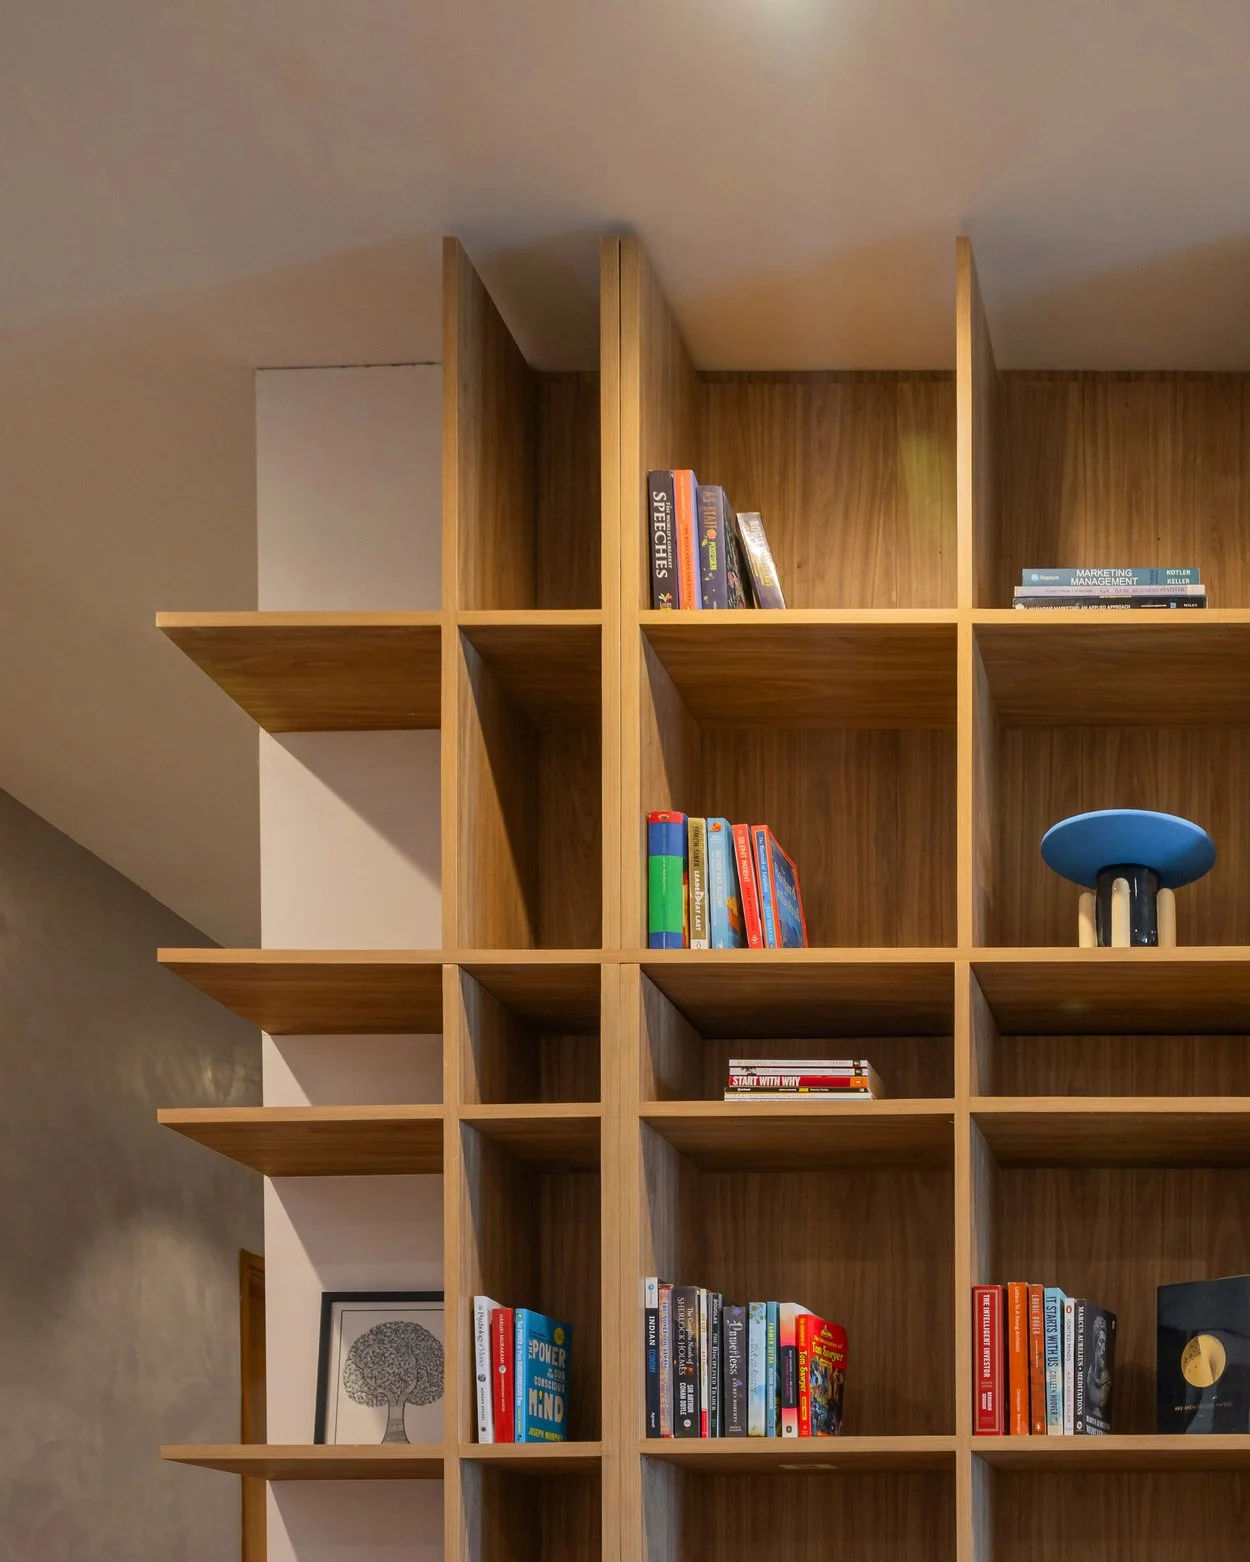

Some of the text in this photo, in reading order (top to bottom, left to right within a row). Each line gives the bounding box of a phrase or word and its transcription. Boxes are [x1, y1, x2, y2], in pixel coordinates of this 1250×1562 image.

[653, 491, 668, 578] SPEECHES
[1070, 577, 1138, 586] MANAGEMENT
[1076, 569, 1133, 577] MARKETING
[732, 1076, 800, 1086] START WITH WHY
[677, 1296, 686, 1376] SHERLOCK HOLMES
[1046, 1296, 1058, 1367] IT STARTS WITH US
[533, 1339, 566, 1368] POWER
[726, 1319, 743, 1375] Powerless
[799, 1350, 807, 1365] Tom
[798, 1366, 808, 1392] Sawyer
